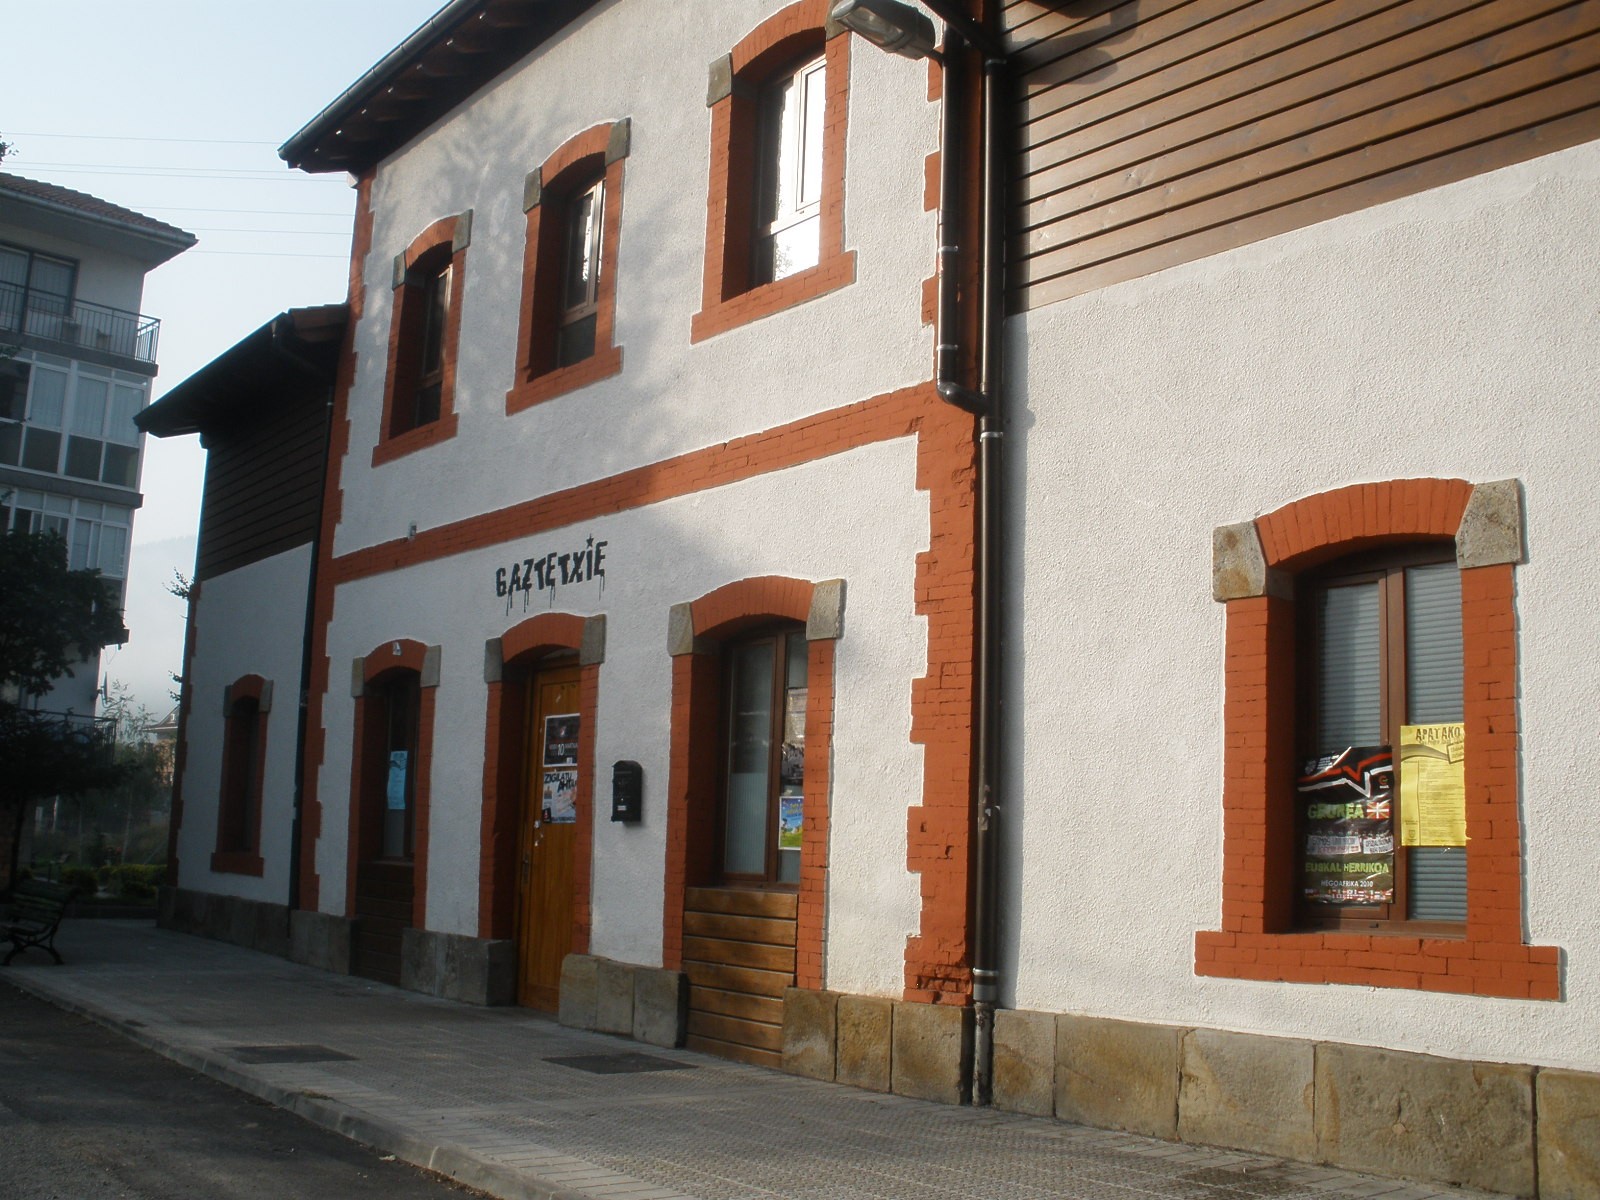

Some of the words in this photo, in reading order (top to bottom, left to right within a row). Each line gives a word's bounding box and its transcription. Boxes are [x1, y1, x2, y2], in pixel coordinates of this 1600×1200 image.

[496, 533, 608, 598] GAZTETXIE
[1305, 862, 1342, 873] EUSKAL
[1343, 862, 1389, 873] HERRIKOA
[1320, 879, 1359, 888] HEGOAFRIKA
